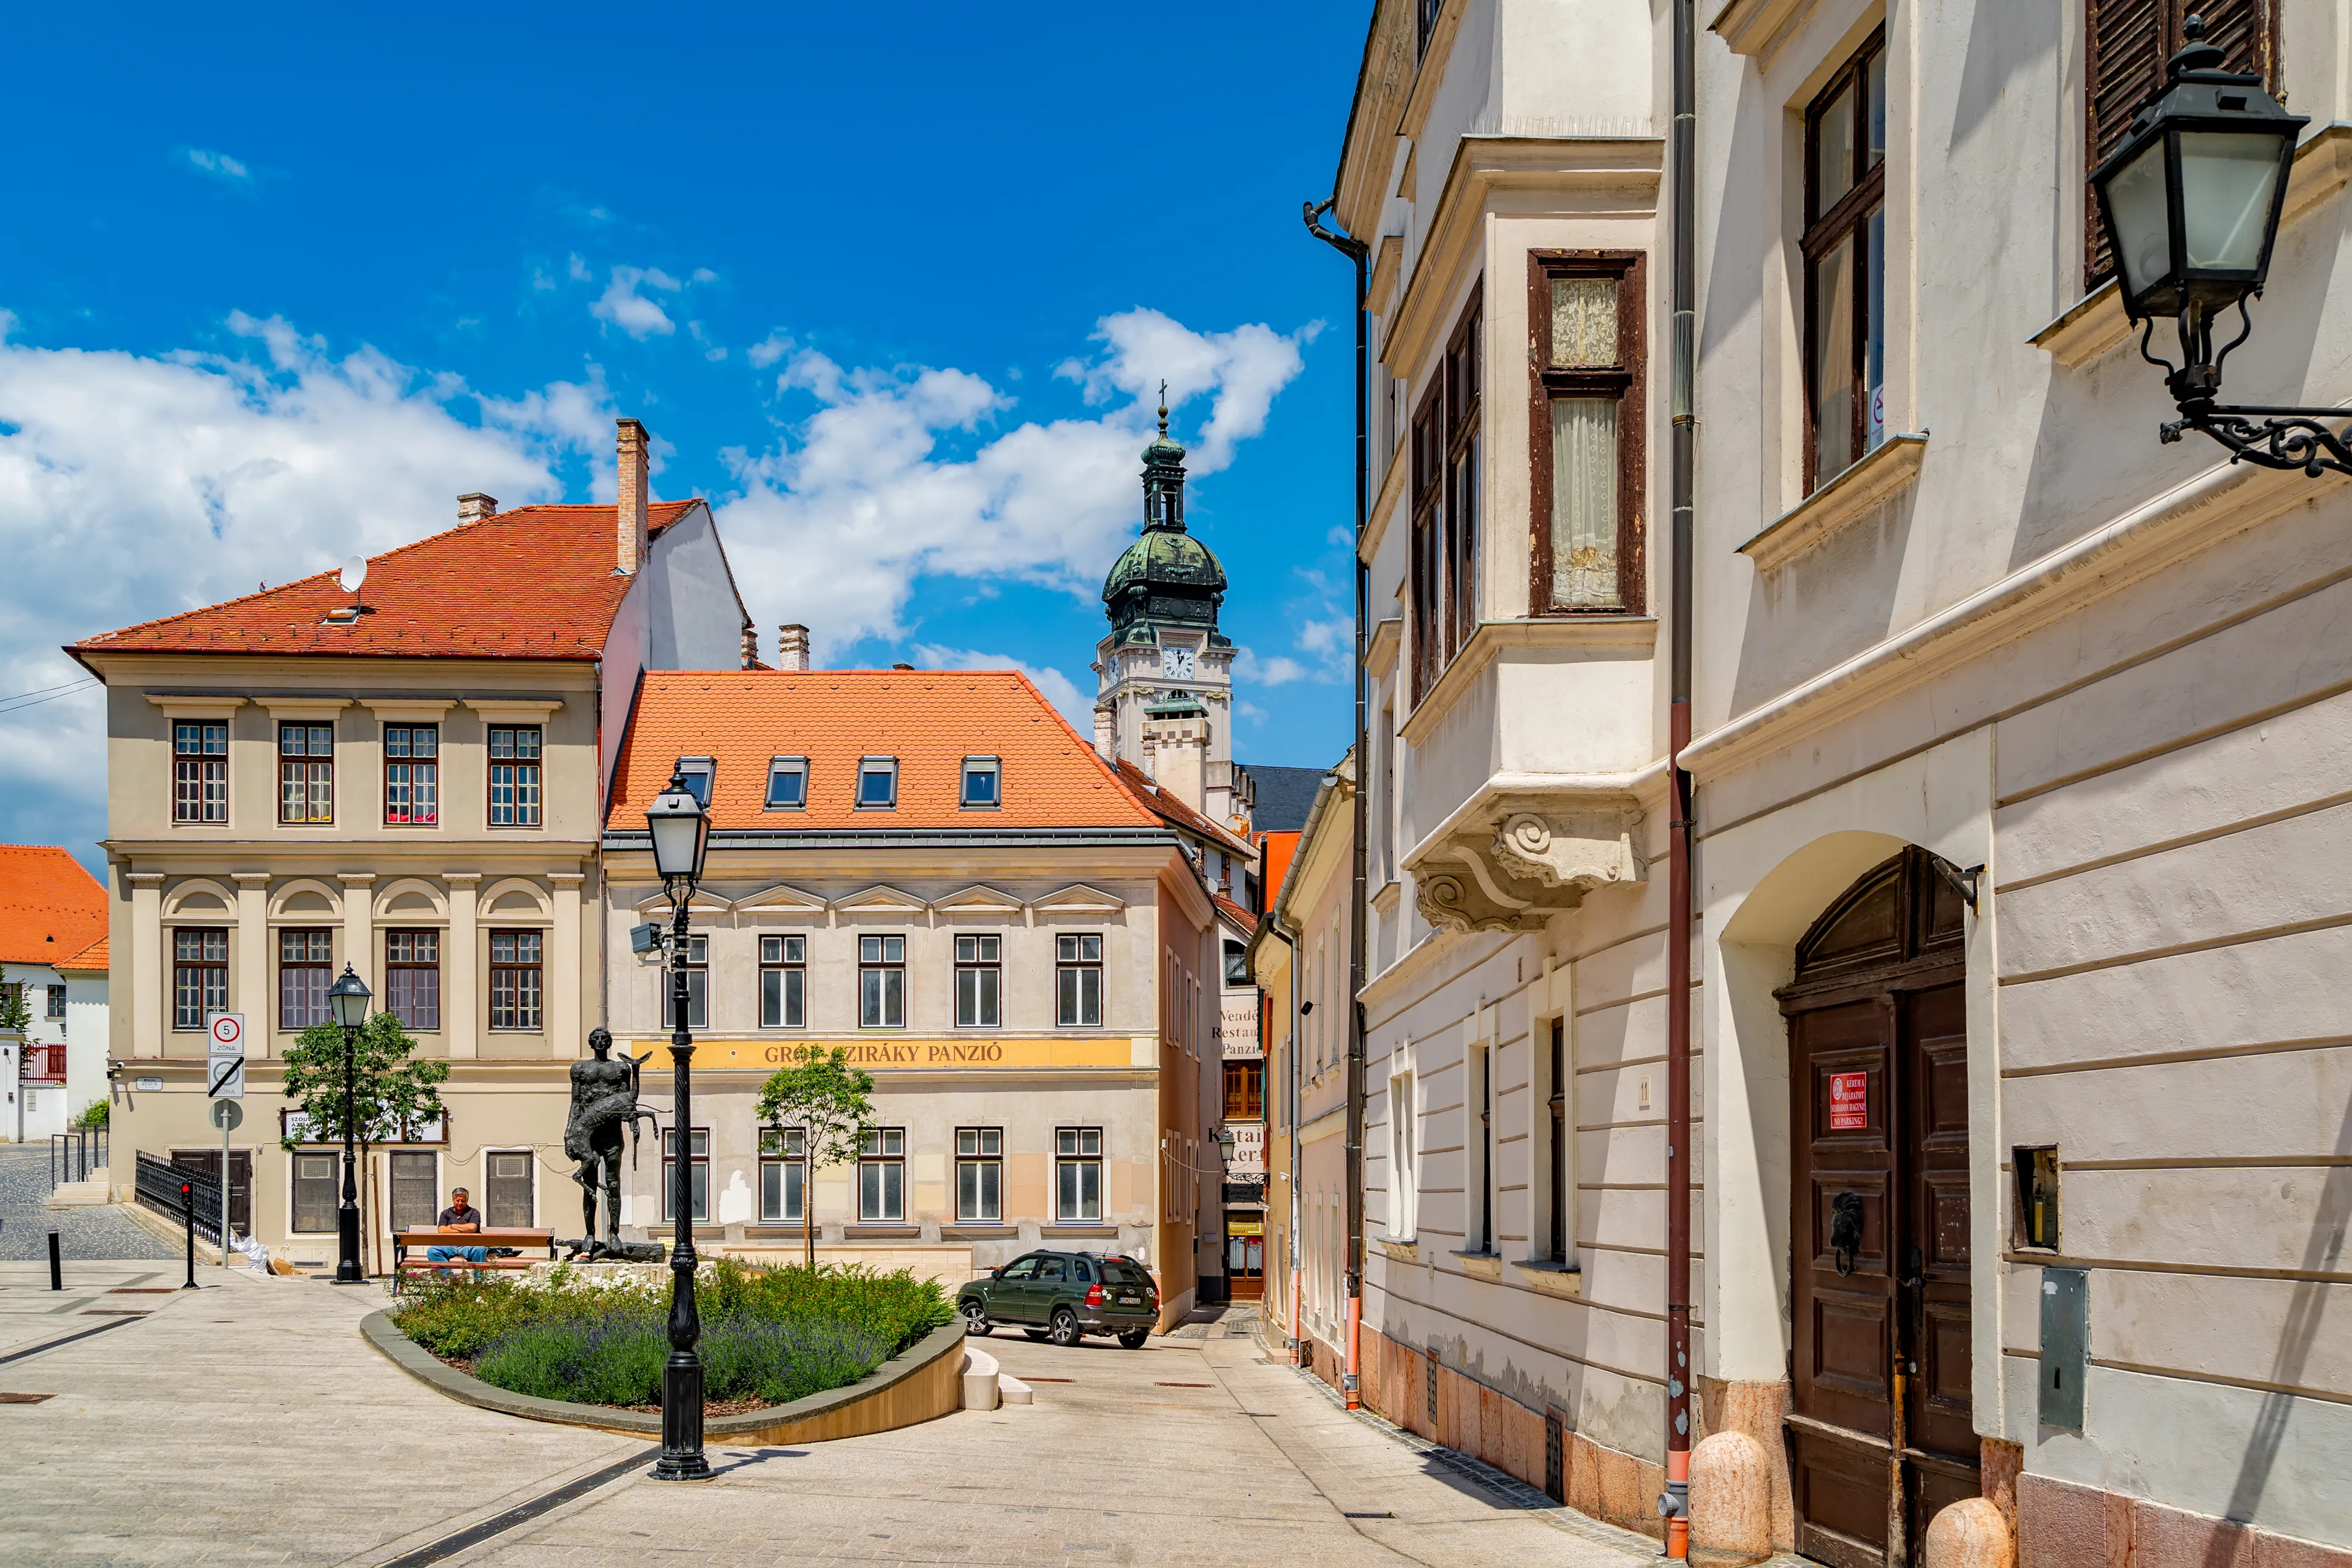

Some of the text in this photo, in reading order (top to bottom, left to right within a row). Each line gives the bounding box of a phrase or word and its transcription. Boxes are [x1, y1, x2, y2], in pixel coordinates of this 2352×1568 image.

[224, 1025, 230, 1035] 5
[765, 1041, 1003, 1062] GRÓ ZIRÁKY PANZIÓ
[1847, 1077, 1864, 1088] KÉREM A
[1641, 1081, 1647, 1101] 11
[1842, 1090, 1864, 1101] BEJÁRATOT
[1831, 1104, 1849, 1112] SZABADON
[1841, 1117, 1863, 1125] PARKING!
[1208, 1127, 1262, 1144] Ktal
